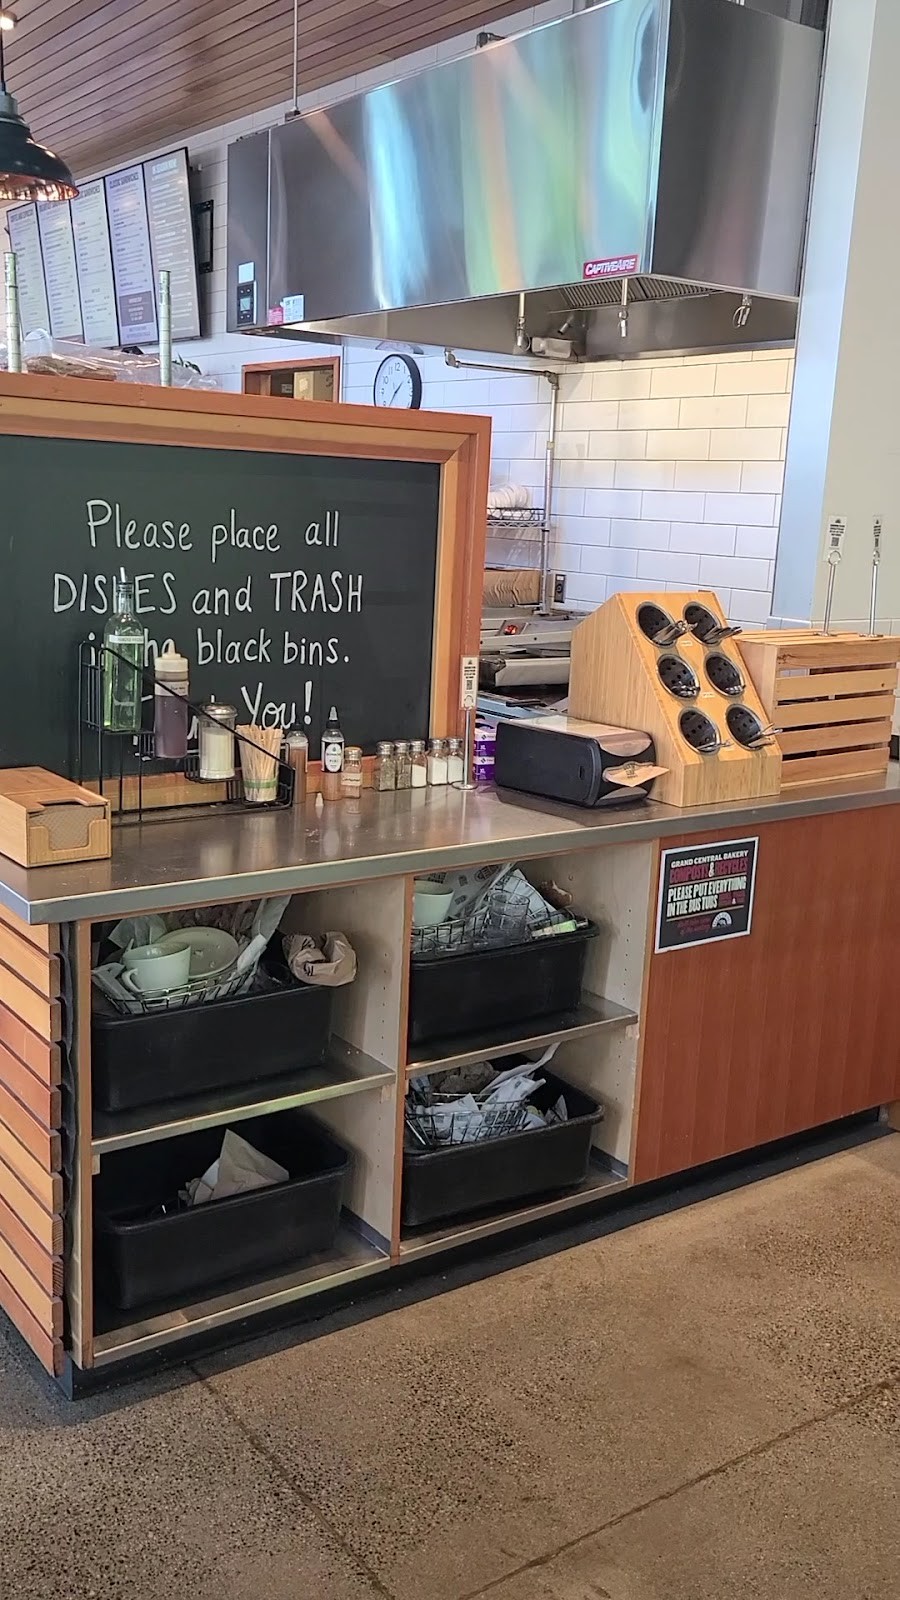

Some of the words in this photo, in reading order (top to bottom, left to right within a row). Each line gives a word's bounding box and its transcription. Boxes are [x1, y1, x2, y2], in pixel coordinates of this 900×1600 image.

[86, 499, 193, 551] Please
[211, 508, 281, 563] place
[304, 510, 340, 548] all
[192, 575, 252, 616] and
[269, 570, 364, 614] TRASH
[197, 628, 272, 667] black
[283, 631, 350, 667] bins.
[241, 681, 314, 730] You!
[671, 858, 694, 868] GRAND
[694, 853, 722, 864] CENTRAL
[723, 850, 748, 860] BAKERY
[708, 862, 715, 878] &
[668, 885, 693, 902] PLEASE
[693, 882, 708, 897] PUT
[708, 876, 747, 895] EVERYTHING
[667, 902, 676, 917] IN
[675, 899, 689, 915] THE
[688, 897, 701, 913] BUS
[701, 895, 718, 910] TUBS
